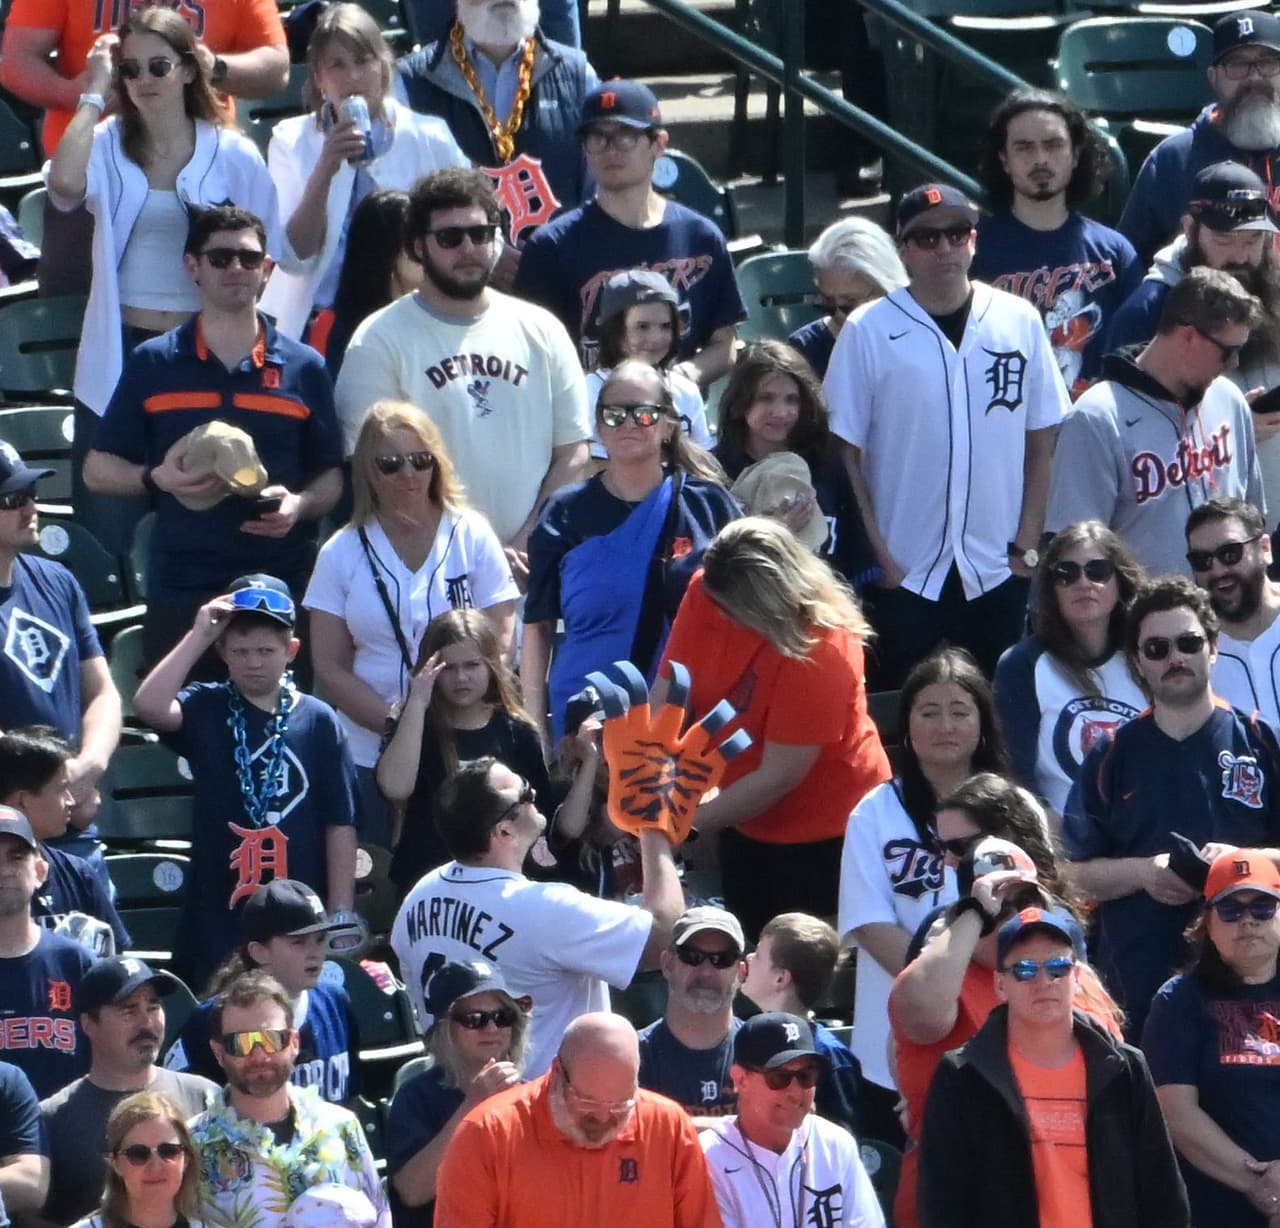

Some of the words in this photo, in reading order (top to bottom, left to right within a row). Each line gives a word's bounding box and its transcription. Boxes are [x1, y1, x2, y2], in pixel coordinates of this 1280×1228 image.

[1238, 17, 1255, 38] D
[480, 153, 561, 247] D
[424, 353, 529, 391] DETROIT
[983, 346, 1028, 414] D
[19, 628, 50, 667] D
[1232, 860, 1252, 876] D
[406, 895, 515, 964] MARTINEZ
[48, 980, 72, 1012] D
[782, 1023, 801, 1043] D
[701, 1080, 719, 1104] D
[619, 1157, 639, 1183] D
